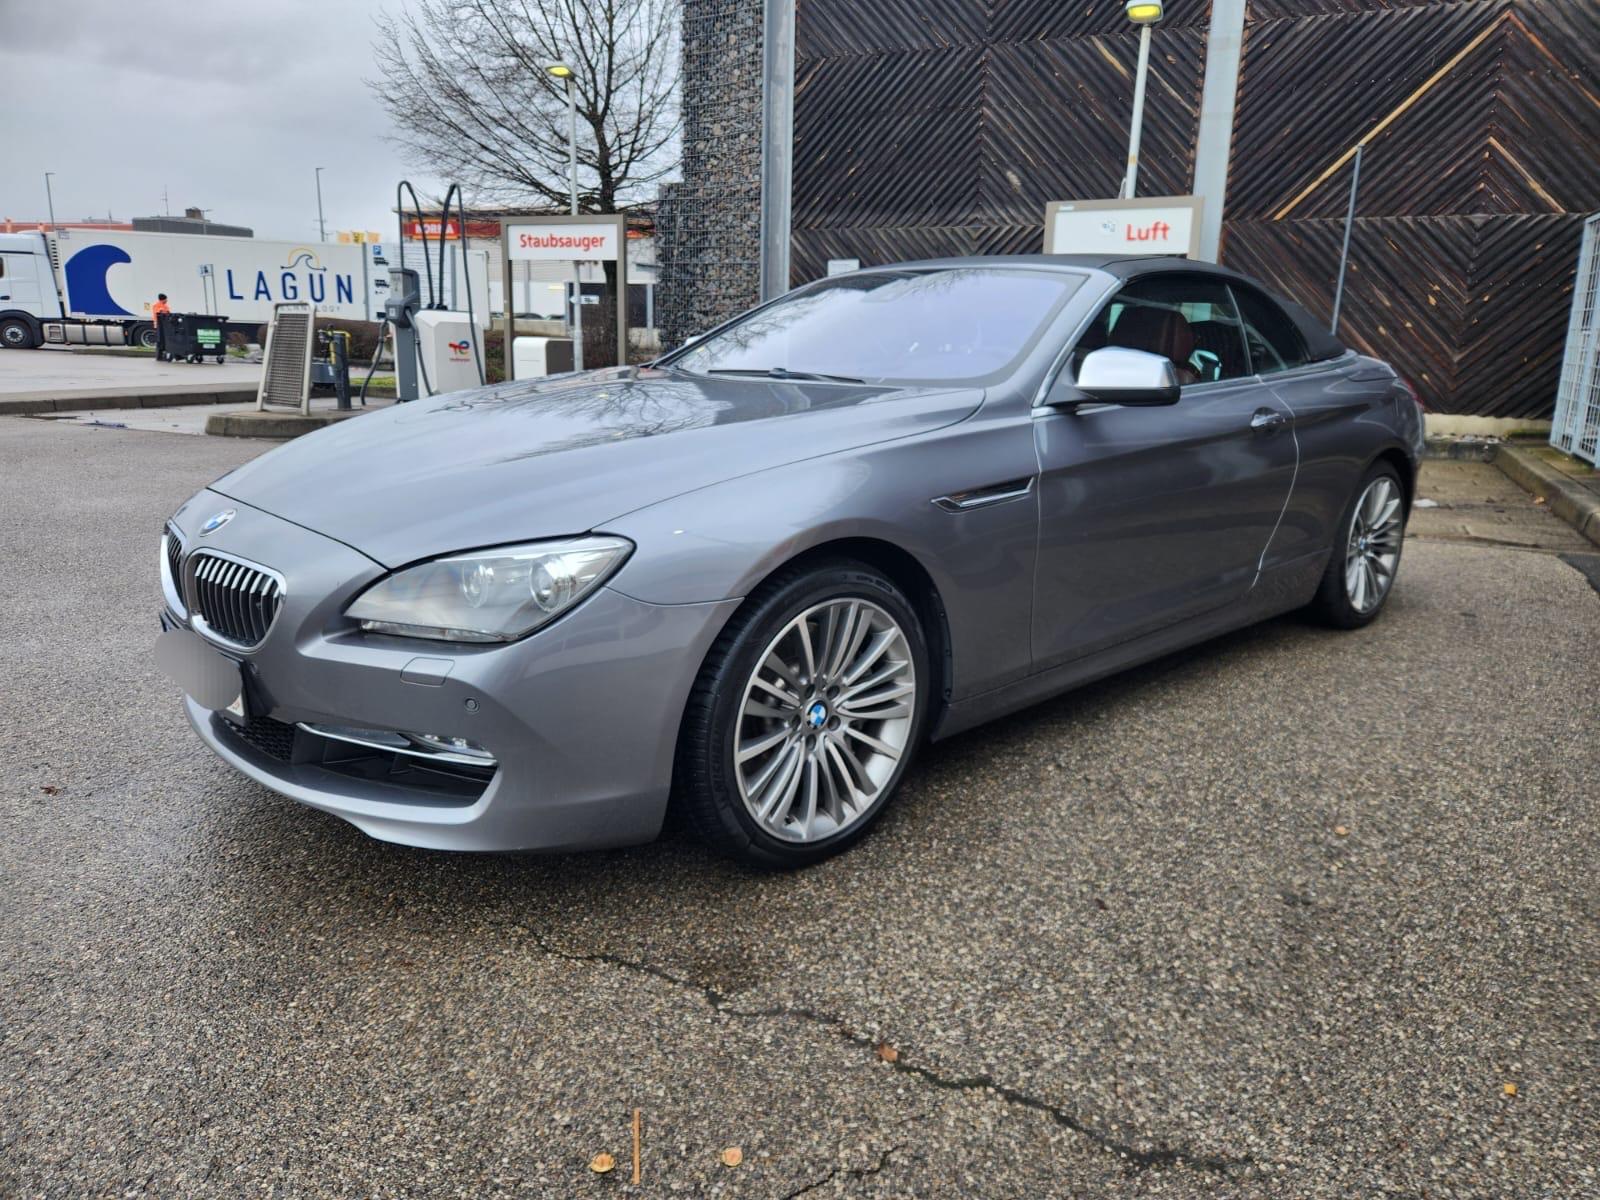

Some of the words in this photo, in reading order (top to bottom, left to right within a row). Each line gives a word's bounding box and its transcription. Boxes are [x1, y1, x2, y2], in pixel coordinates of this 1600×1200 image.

[415, 223, 455, 234] NORA
[1126, 221, 1170, 241] Luft
[520, 233, 606, 251] Staubsauger
[227, 269, 353, 304] LAGUN
